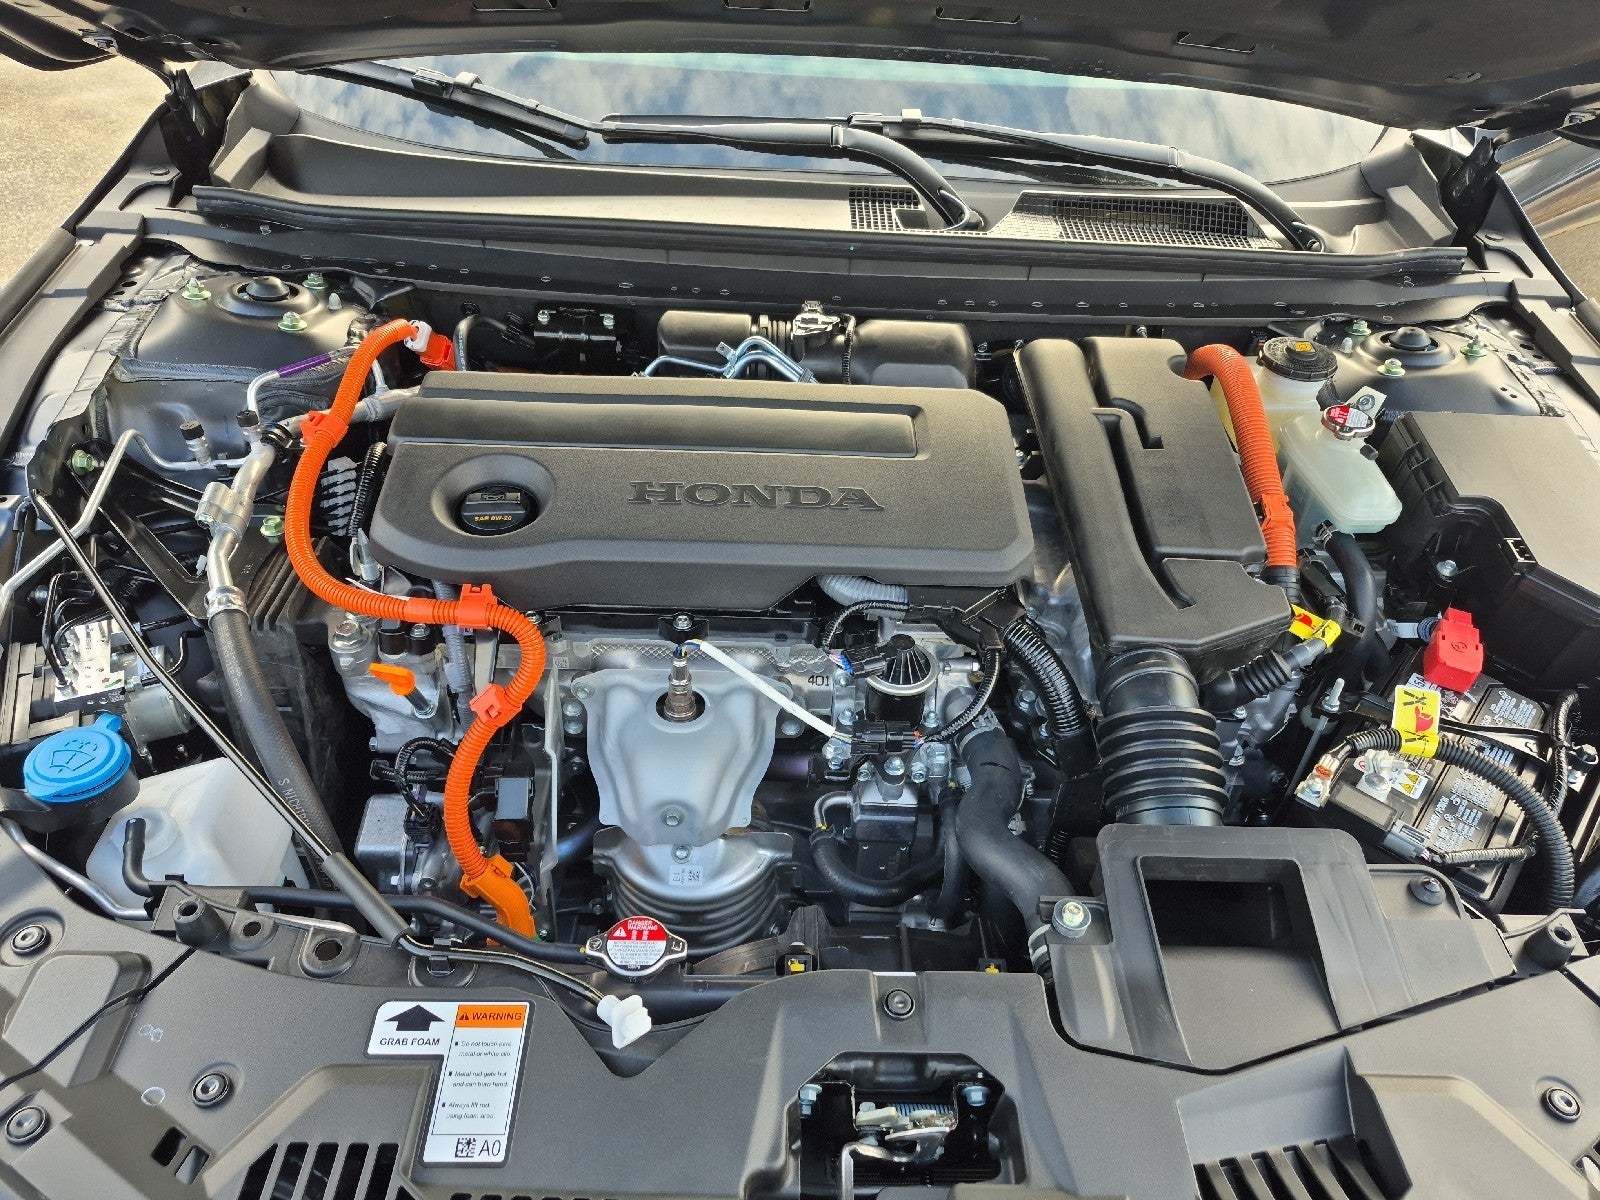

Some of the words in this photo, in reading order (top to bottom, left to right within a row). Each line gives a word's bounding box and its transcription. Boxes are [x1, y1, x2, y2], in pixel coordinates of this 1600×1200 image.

[628, 481, 885, 510] HONDA
[808, 675, 829, 686] 401
[472, 1012, 522, 1021] WARNING
[380, 1037, 408, 1046] GRAB
[410, 1037, 441, 1046] FOAM
[478, 1140, 502, 1156] A0
